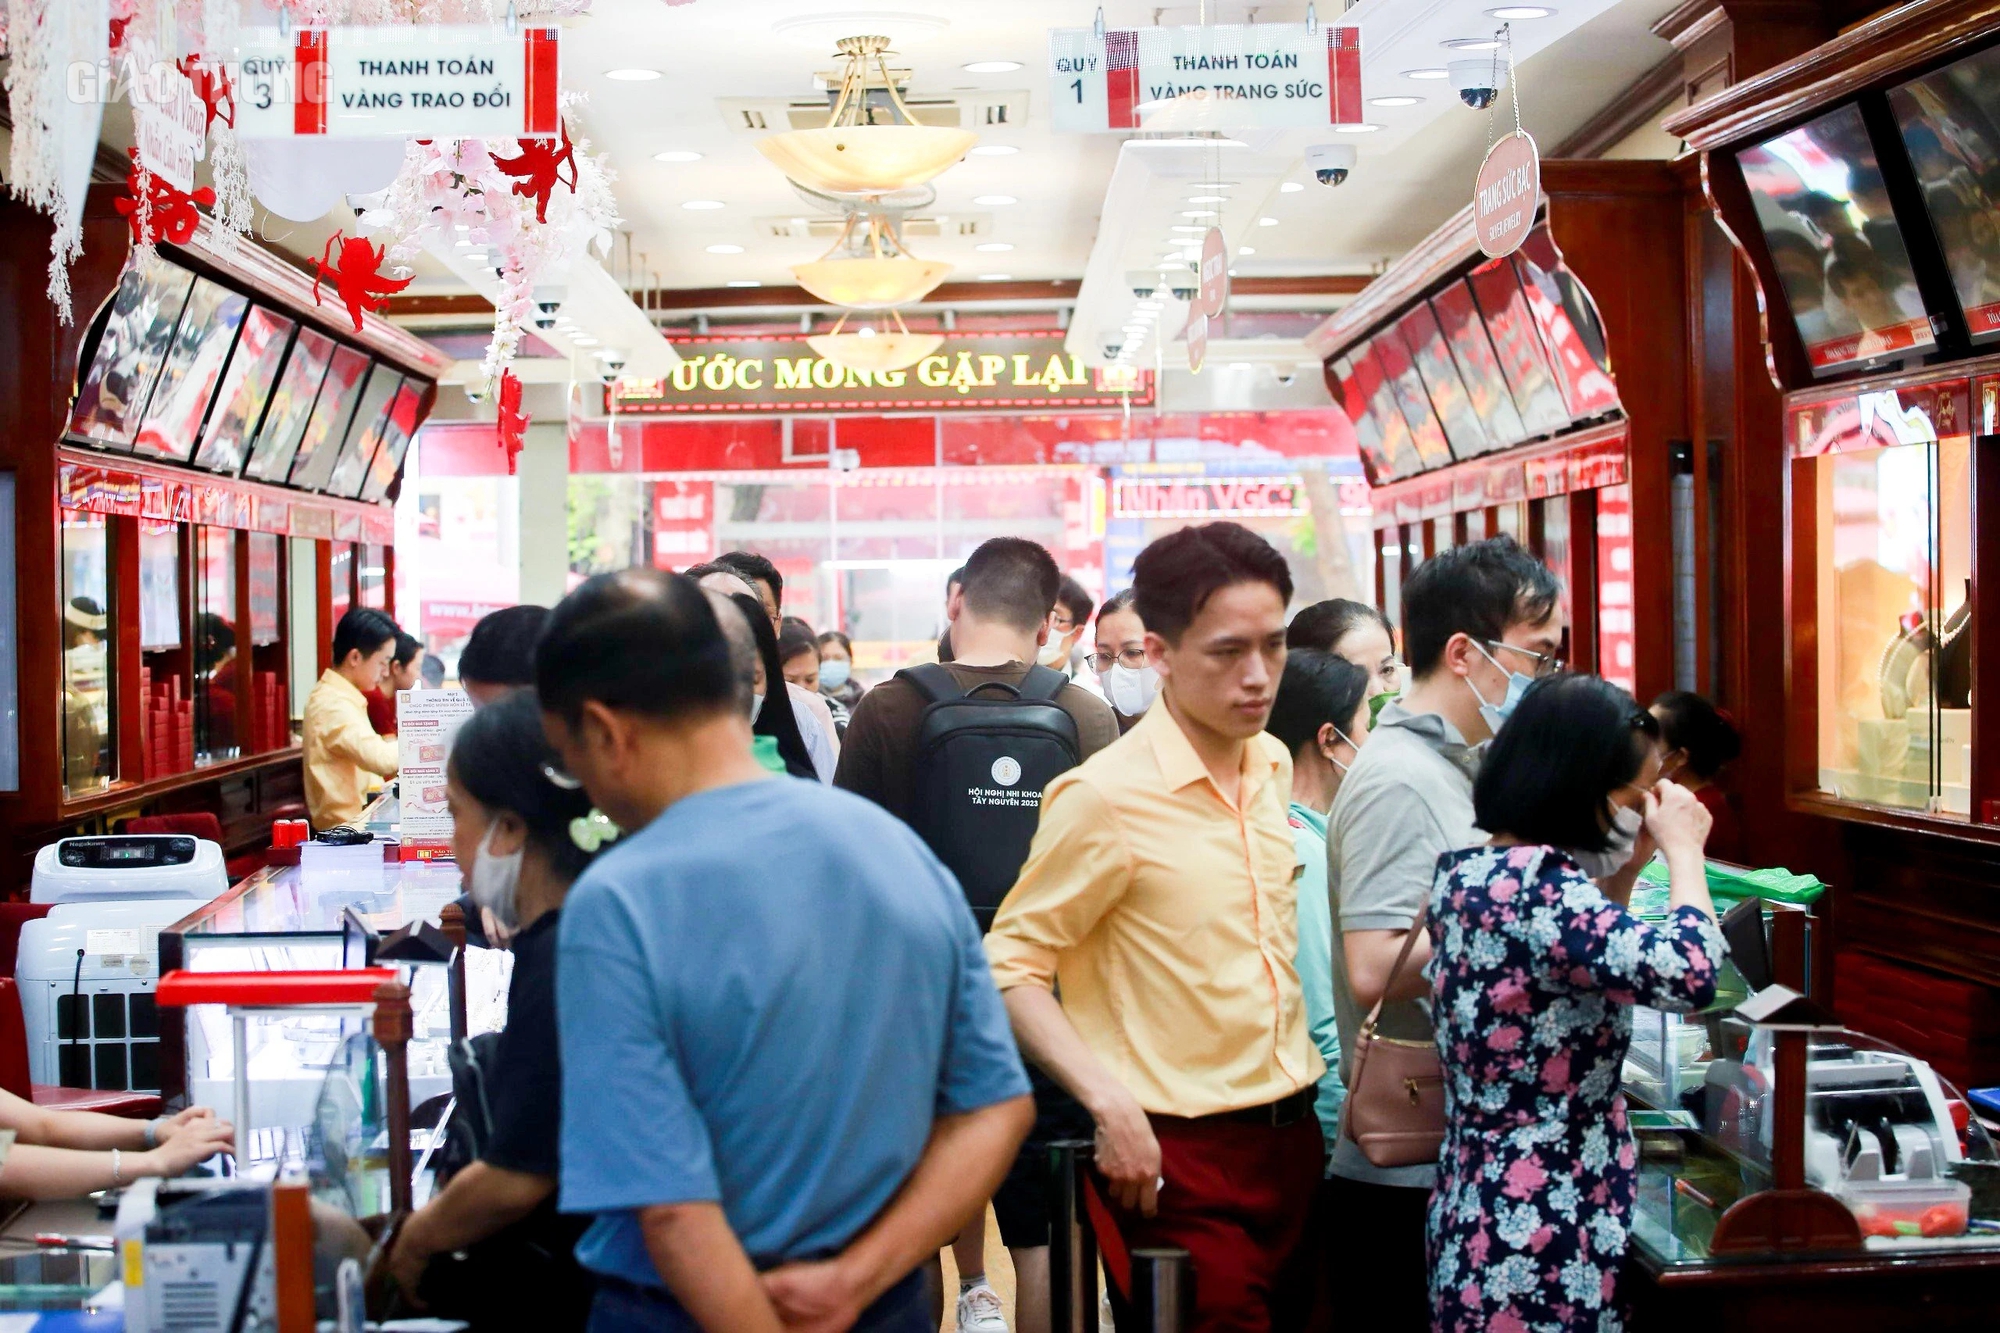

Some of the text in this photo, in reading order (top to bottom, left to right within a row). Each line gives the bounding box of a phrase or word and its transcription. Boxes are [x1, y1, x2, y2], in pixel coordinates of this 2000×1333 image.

[359, 54, 494, 76] THANH TOÁN
[1173, 50, 1298, 70] THANH TOÁN
[256, 83, 271, 109] 3
[342, 82, 511, 108] VÀNG TRAO ĐỔI
[1070, 78, 1083, 103] 1
[1150, 80, 1323, 100] VÀNG TRANG SỨC
[1479, 160, 1531, 218] TRANG SỨC BẠC
[672, 353, 763, 391] ƯỚC
[917, 351, 1006, 394] GẶP
[1012, 354, 1088, 393] LẠI
[968, 787, 1043, 799] HỘI NGHỊ NHI KHOA
[972, 797, 986, 805] TÂY
[988, 798, 1019, 806] NGUYÊN
